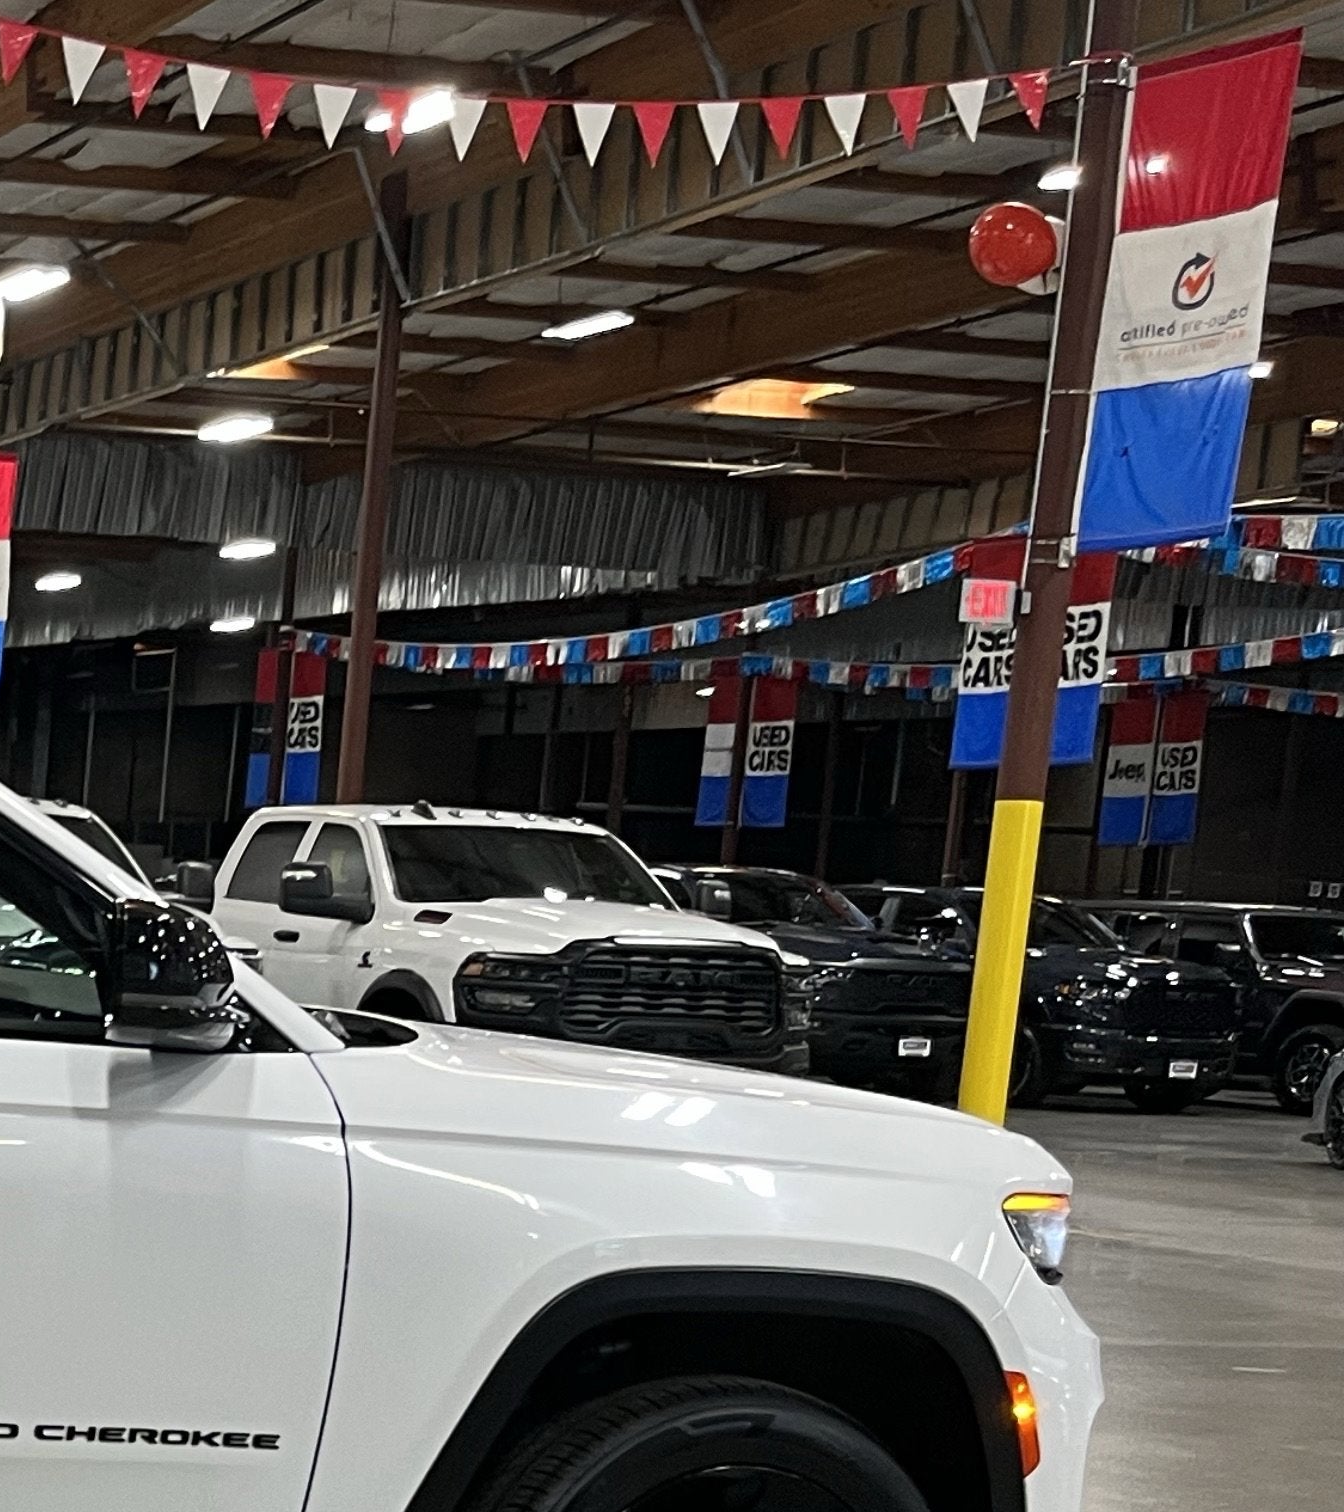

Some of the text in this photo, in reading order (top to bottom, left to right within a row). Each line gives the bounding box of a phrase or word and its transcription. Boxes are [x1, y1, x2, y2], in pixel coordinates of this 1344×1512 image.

[1063, 609, 1103, 645] SED
[1061, 645, 1100, 681] ARS
[32, 1423, 282, 1451] CHEROKEE
